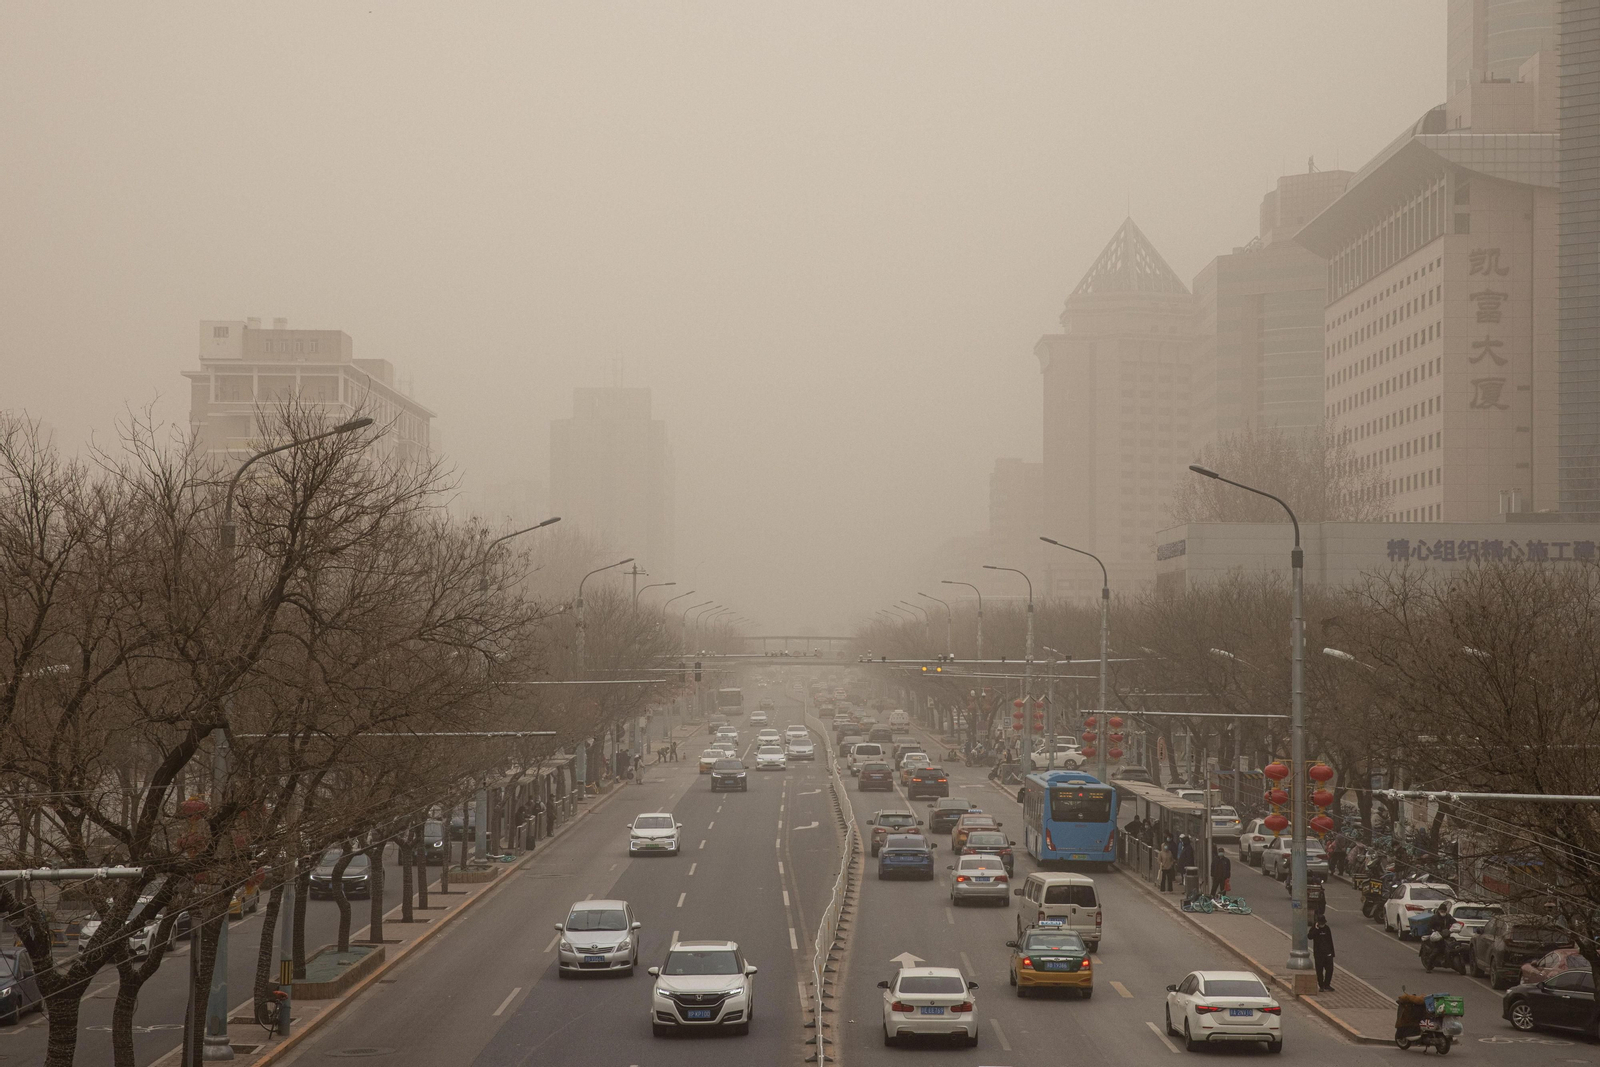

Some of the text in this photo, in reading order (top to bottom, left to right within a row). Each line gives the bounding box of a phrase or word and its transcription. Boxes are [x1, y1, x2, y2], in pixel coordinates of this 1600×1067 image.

[1468, 248, 1510, 410] 凯富大厦
[1387, 538, 1600, 563] 精心组织精心施工建
